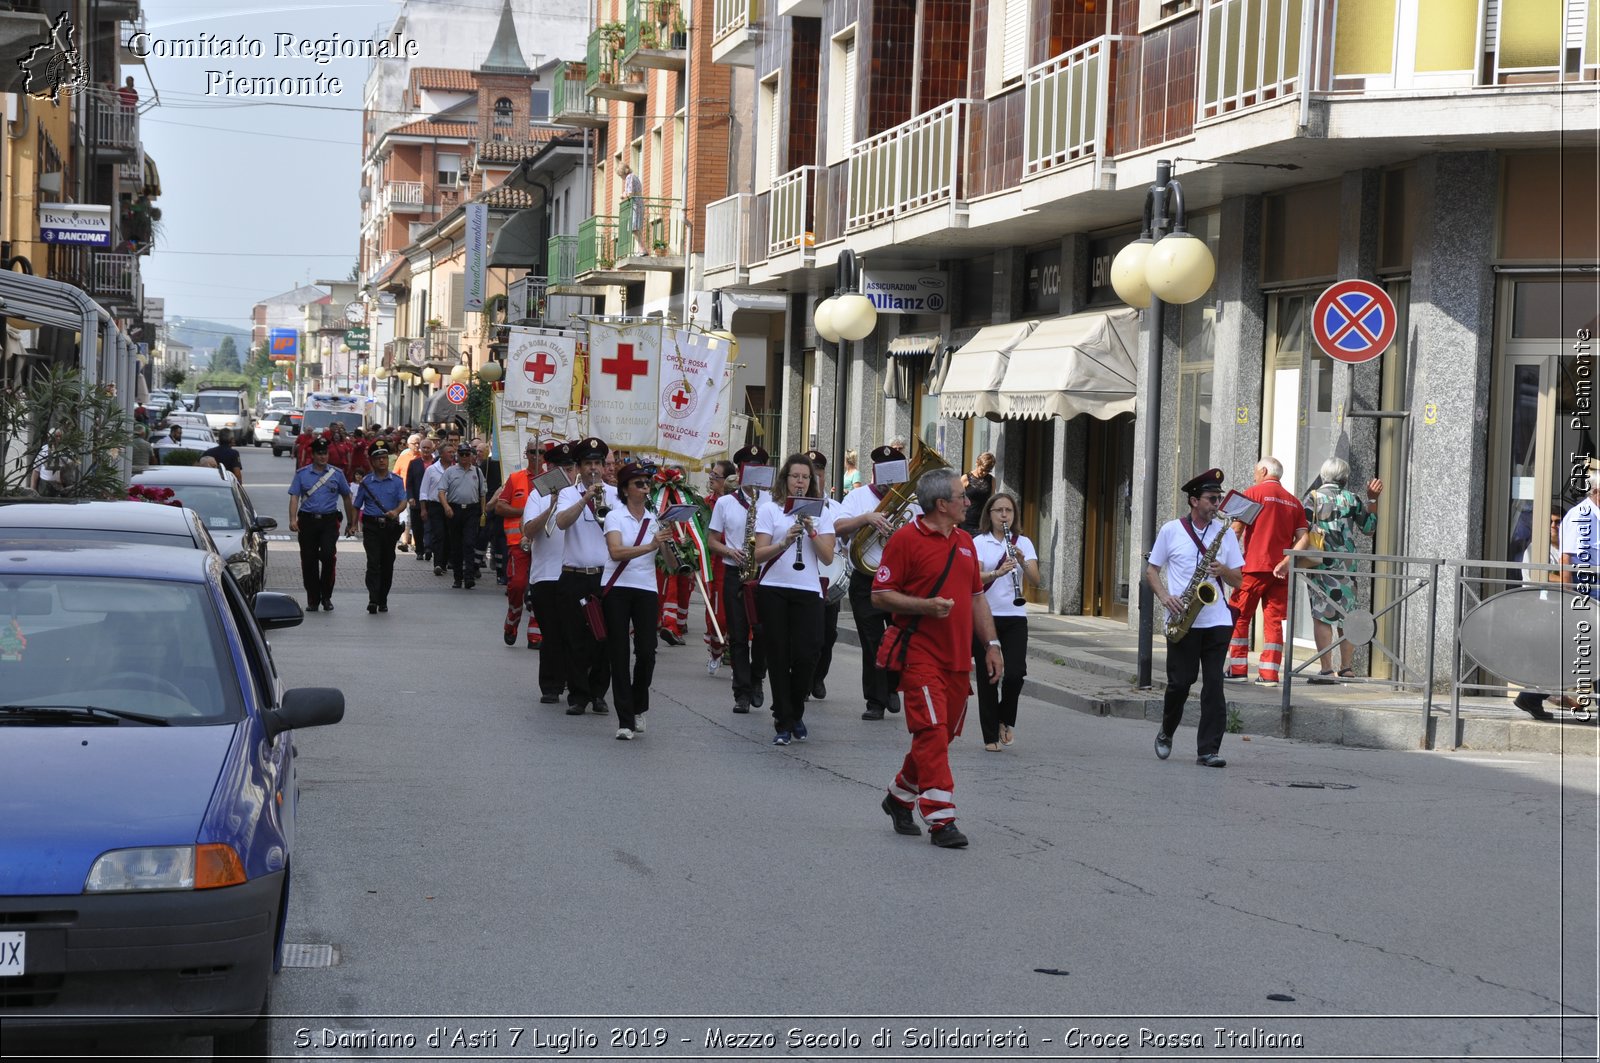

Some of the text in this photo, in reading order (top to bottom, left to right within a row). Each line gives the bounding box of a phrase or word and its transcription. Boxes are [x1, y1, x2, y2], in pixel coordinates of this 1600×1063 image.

[45, 214, 74, 225] BANCA
[58, 231, 107, 243] BANCOMAT
[866, 282, 918, 291] ASSICURAZIONI
[866, 293, 924, 310] Allianz
[512, 339, 569, 368] CROCE ROSSA ITALIANA
[688, 359, 708, 369] ROSSA
[526, 387, 550, 397] GRUPPO
[504, 400, 548, 411] VILLAFRANCA
[589, 400, 657, 411] COMITATO LOCALE
[676, 427, 699, 438] LOCALE
